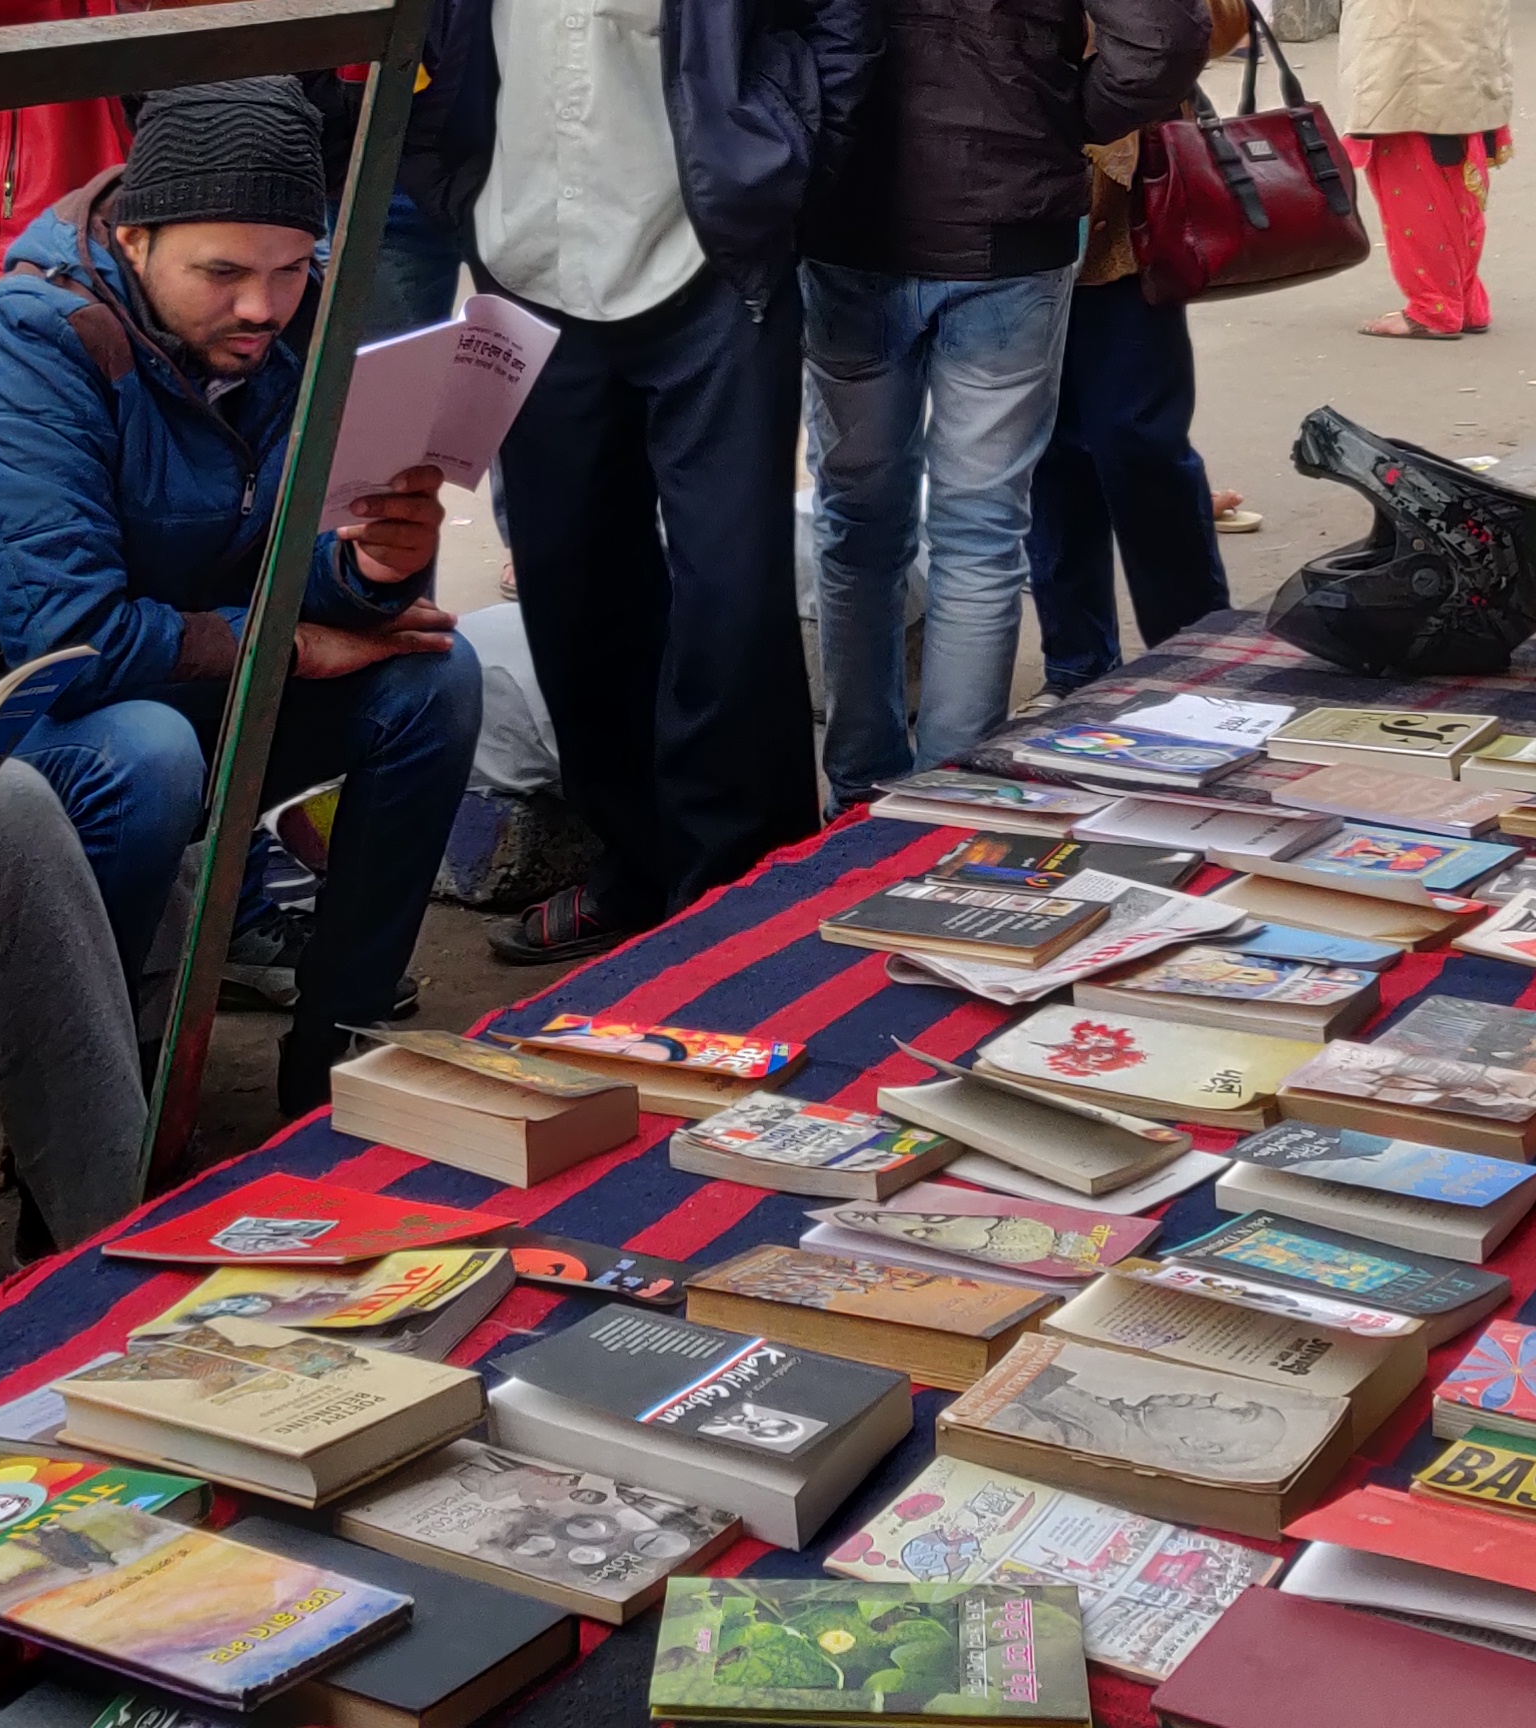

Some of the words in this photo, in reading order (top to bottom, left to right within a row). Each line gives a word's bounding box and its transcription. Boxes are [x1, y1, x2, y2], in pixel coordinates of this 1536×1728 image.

[1396, 1278, 1480, 1309] FIRE
[710, 1347, 797, 1388] Kahlil
[991, 1336, 1066, 1398] JAWAHARLAL
[267, 1391, 378, 1435] BELONGING
[312, 1394, 392, 1425] POETRY
[655, 1382, 742, 1426] Gibran
[446, 1500, 489, 1521] the
[413, 1514, 468, 1540] cold
[608, 1560, 659, 1585] Joe
[285, 1584, 348, 1614] एक
